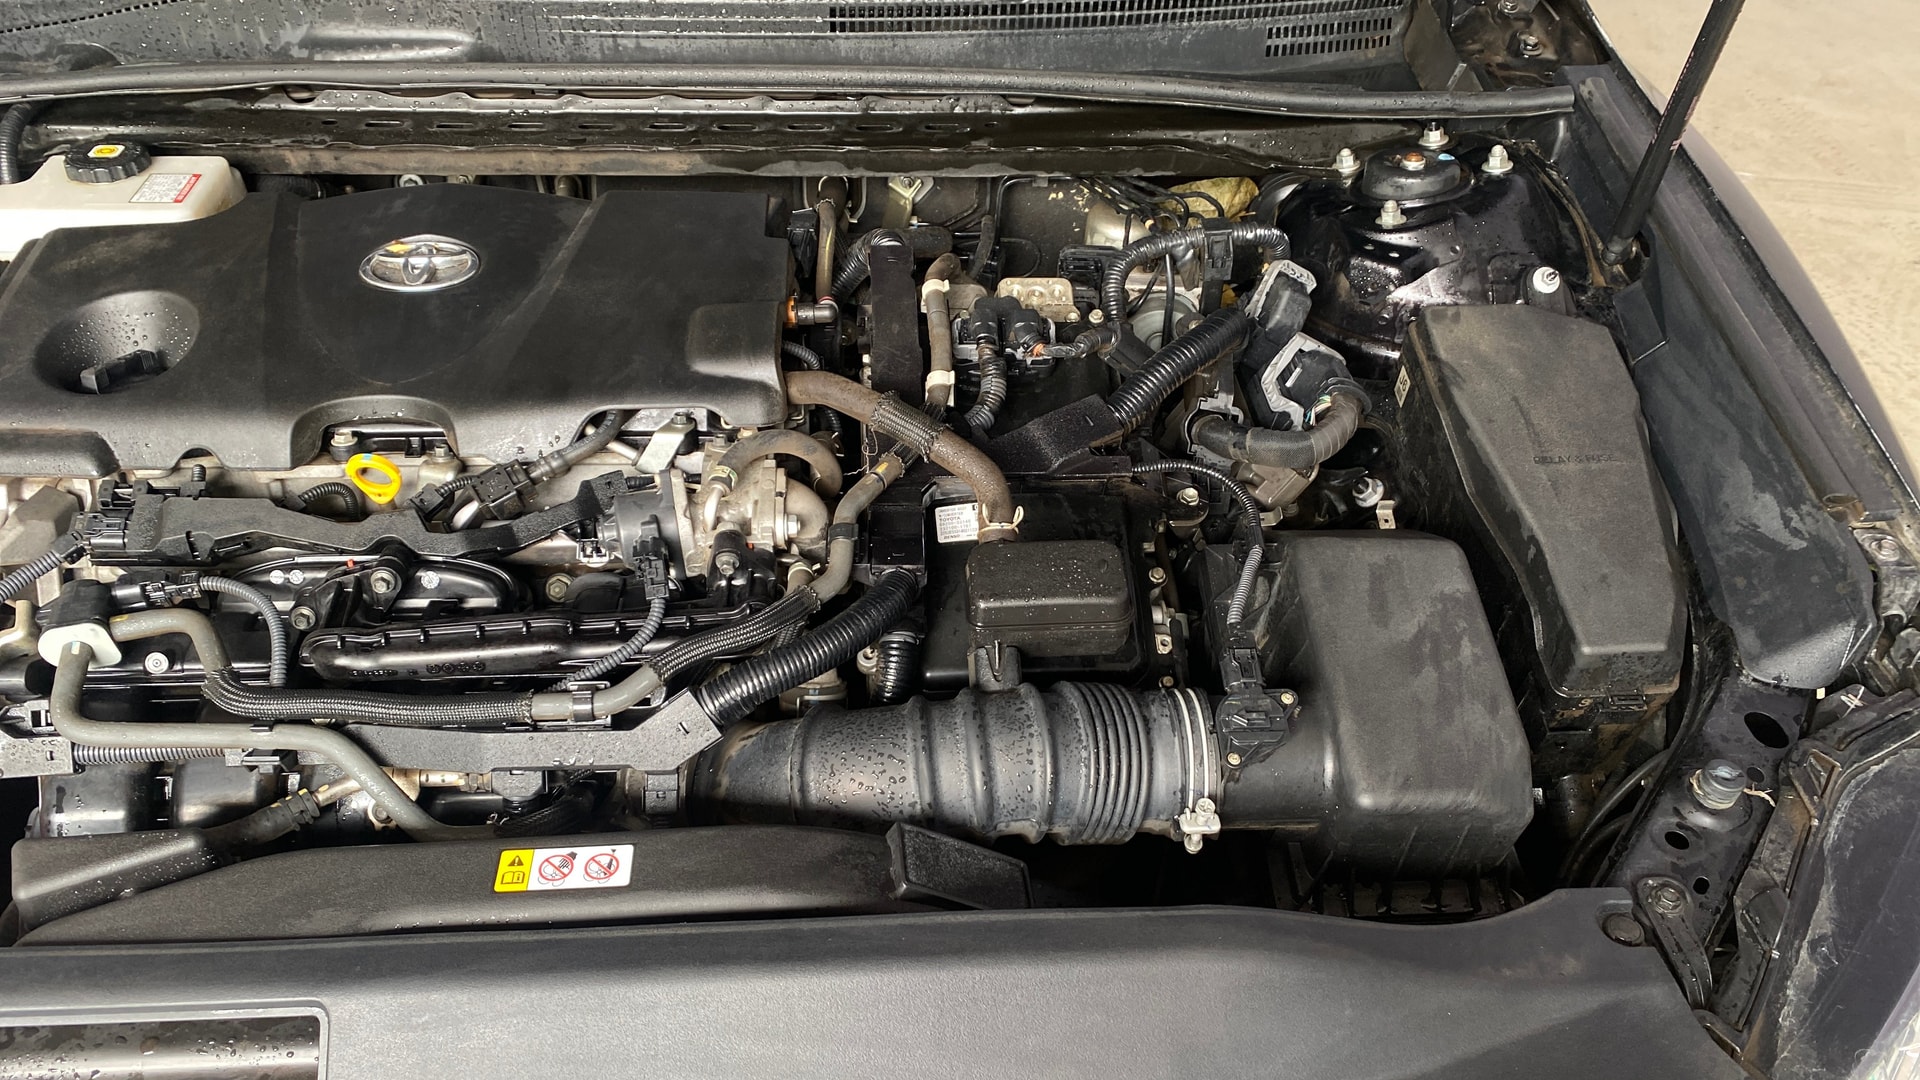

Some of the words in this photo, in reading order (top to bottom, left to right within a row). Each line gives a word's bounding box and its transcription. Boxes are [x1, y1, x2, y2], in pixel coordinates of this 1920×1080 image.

[1533, 455, 1571, 465] RELAY
[1574, 454, 1582, 464] &
[1585, 453, 1617, 463] FUSE
